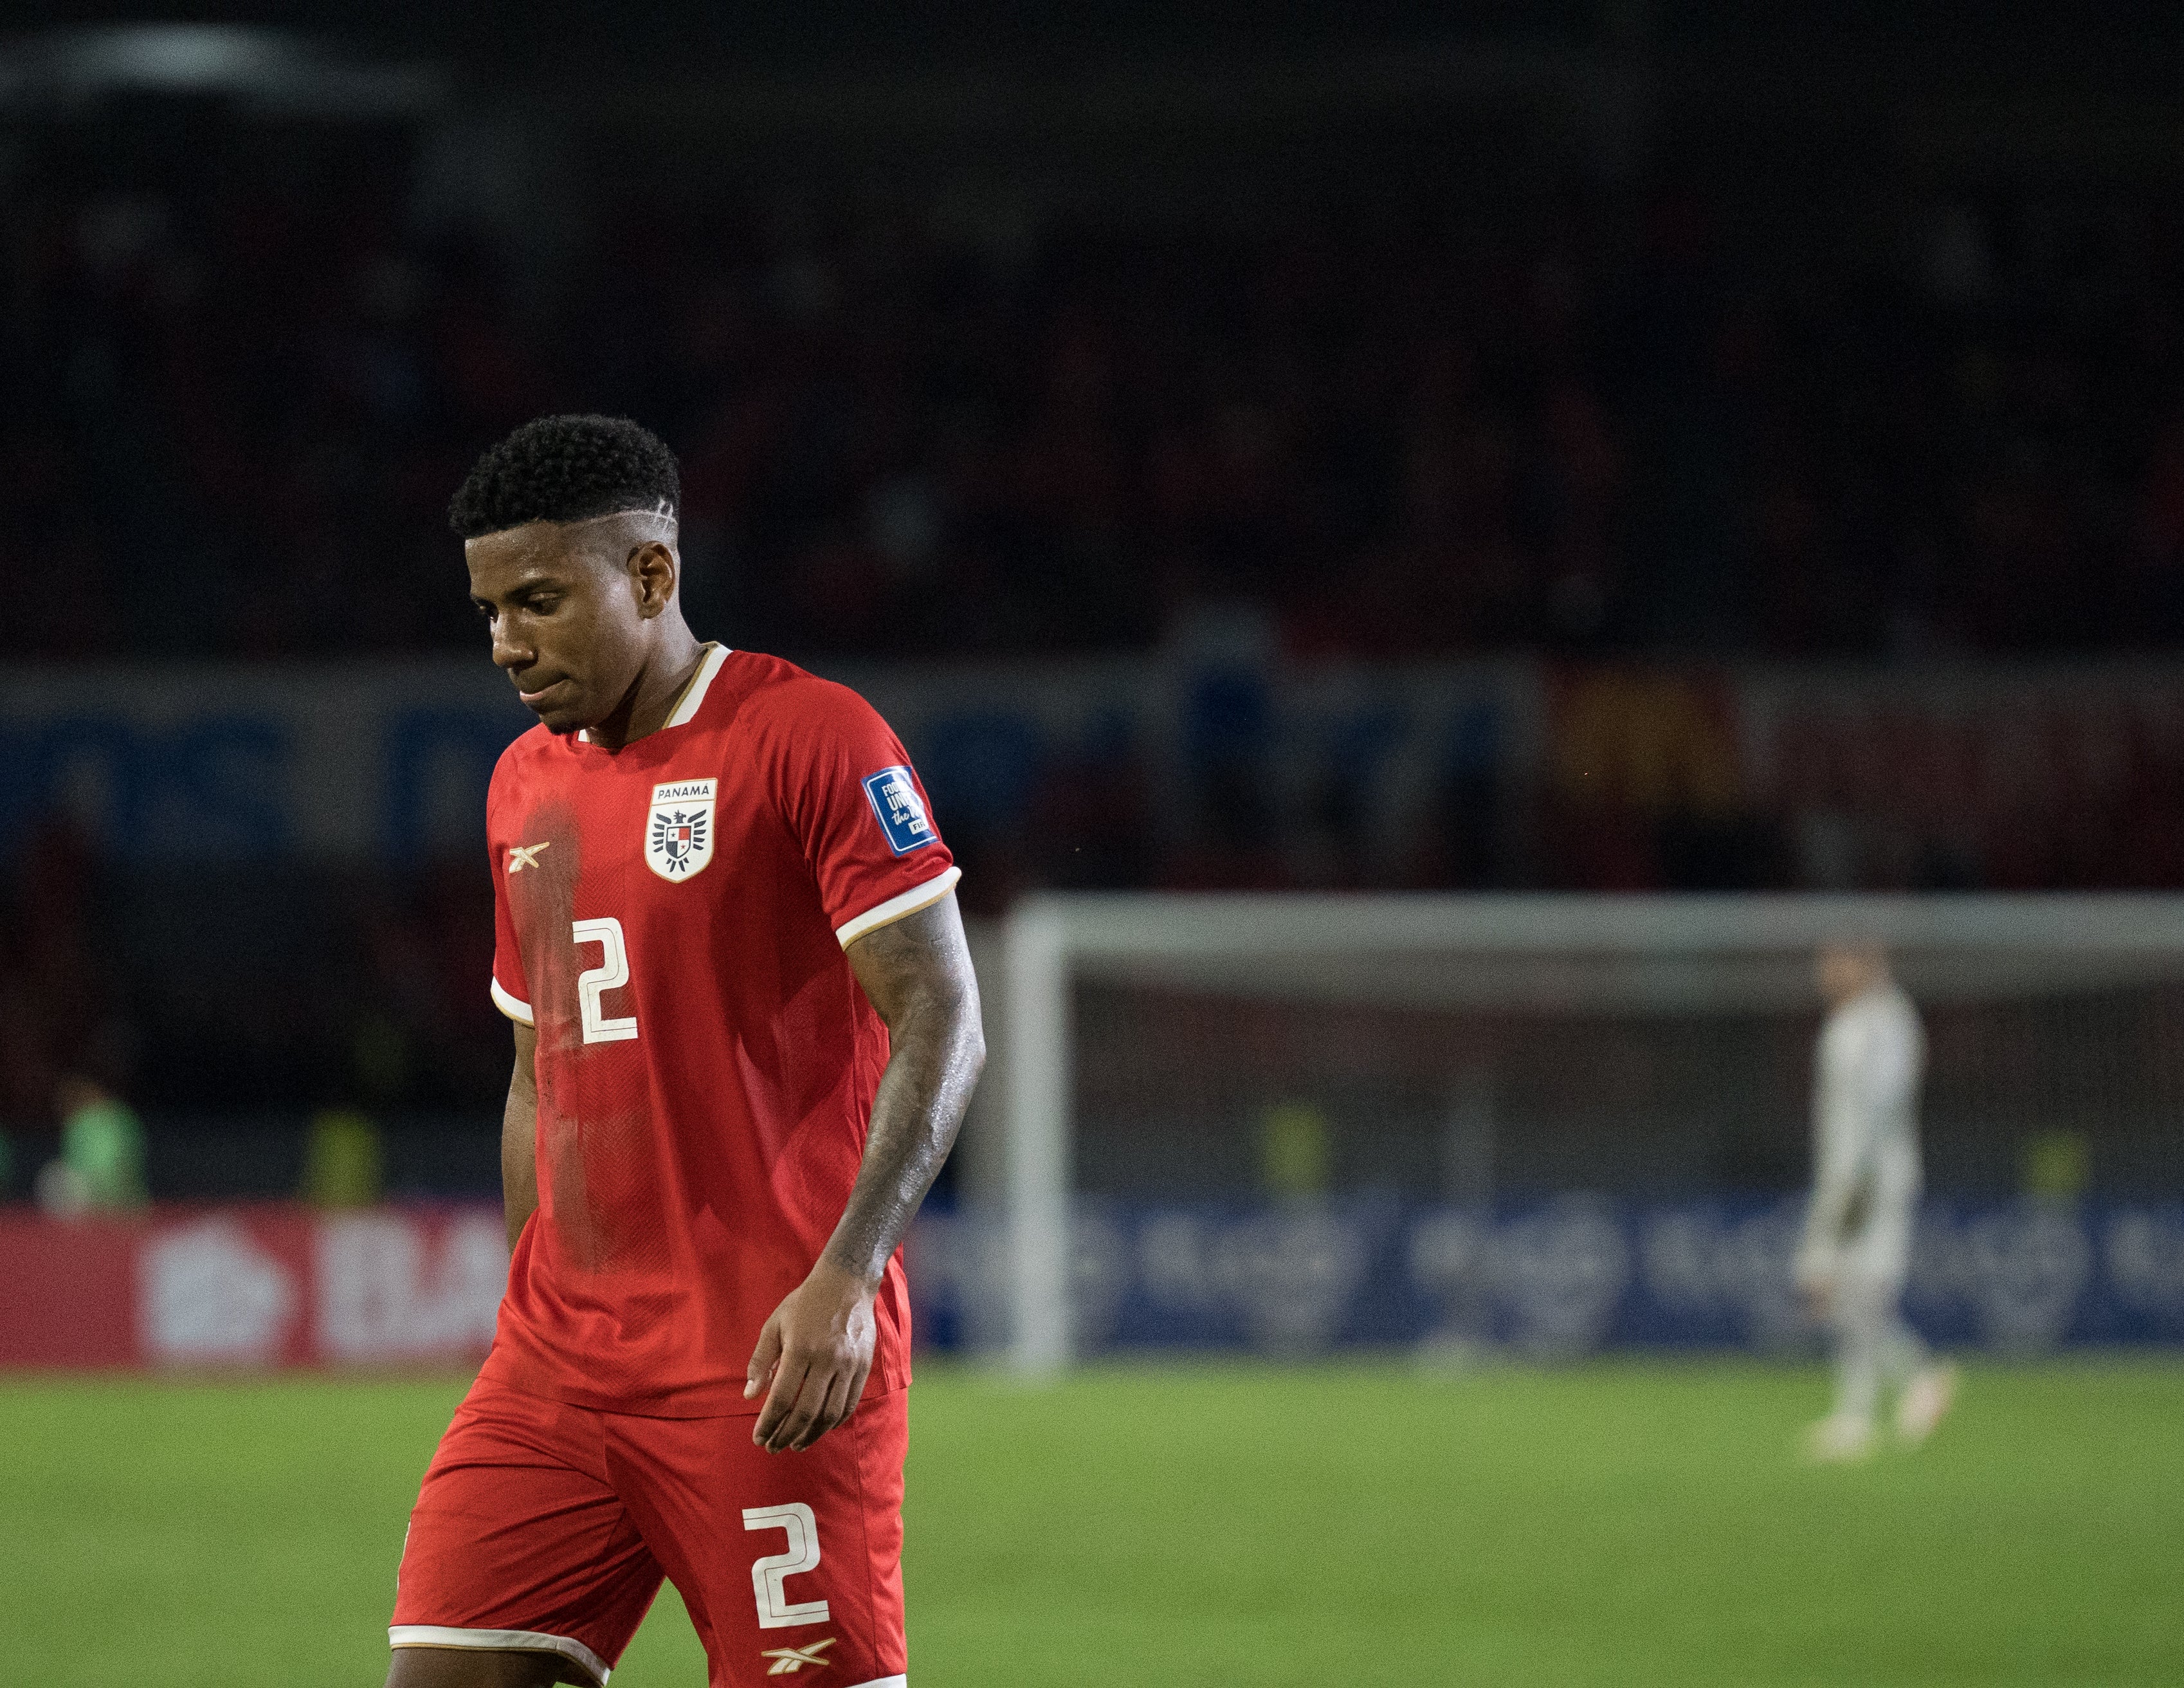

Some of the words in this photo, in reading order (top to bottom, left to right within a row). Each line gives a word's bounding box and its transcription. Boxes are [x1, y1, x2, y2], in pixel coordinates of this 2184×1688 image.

[891, 811, 909, 825] the
[572, 917, 638, 1044] 2
[742, 1502, 830, 1629] 2
